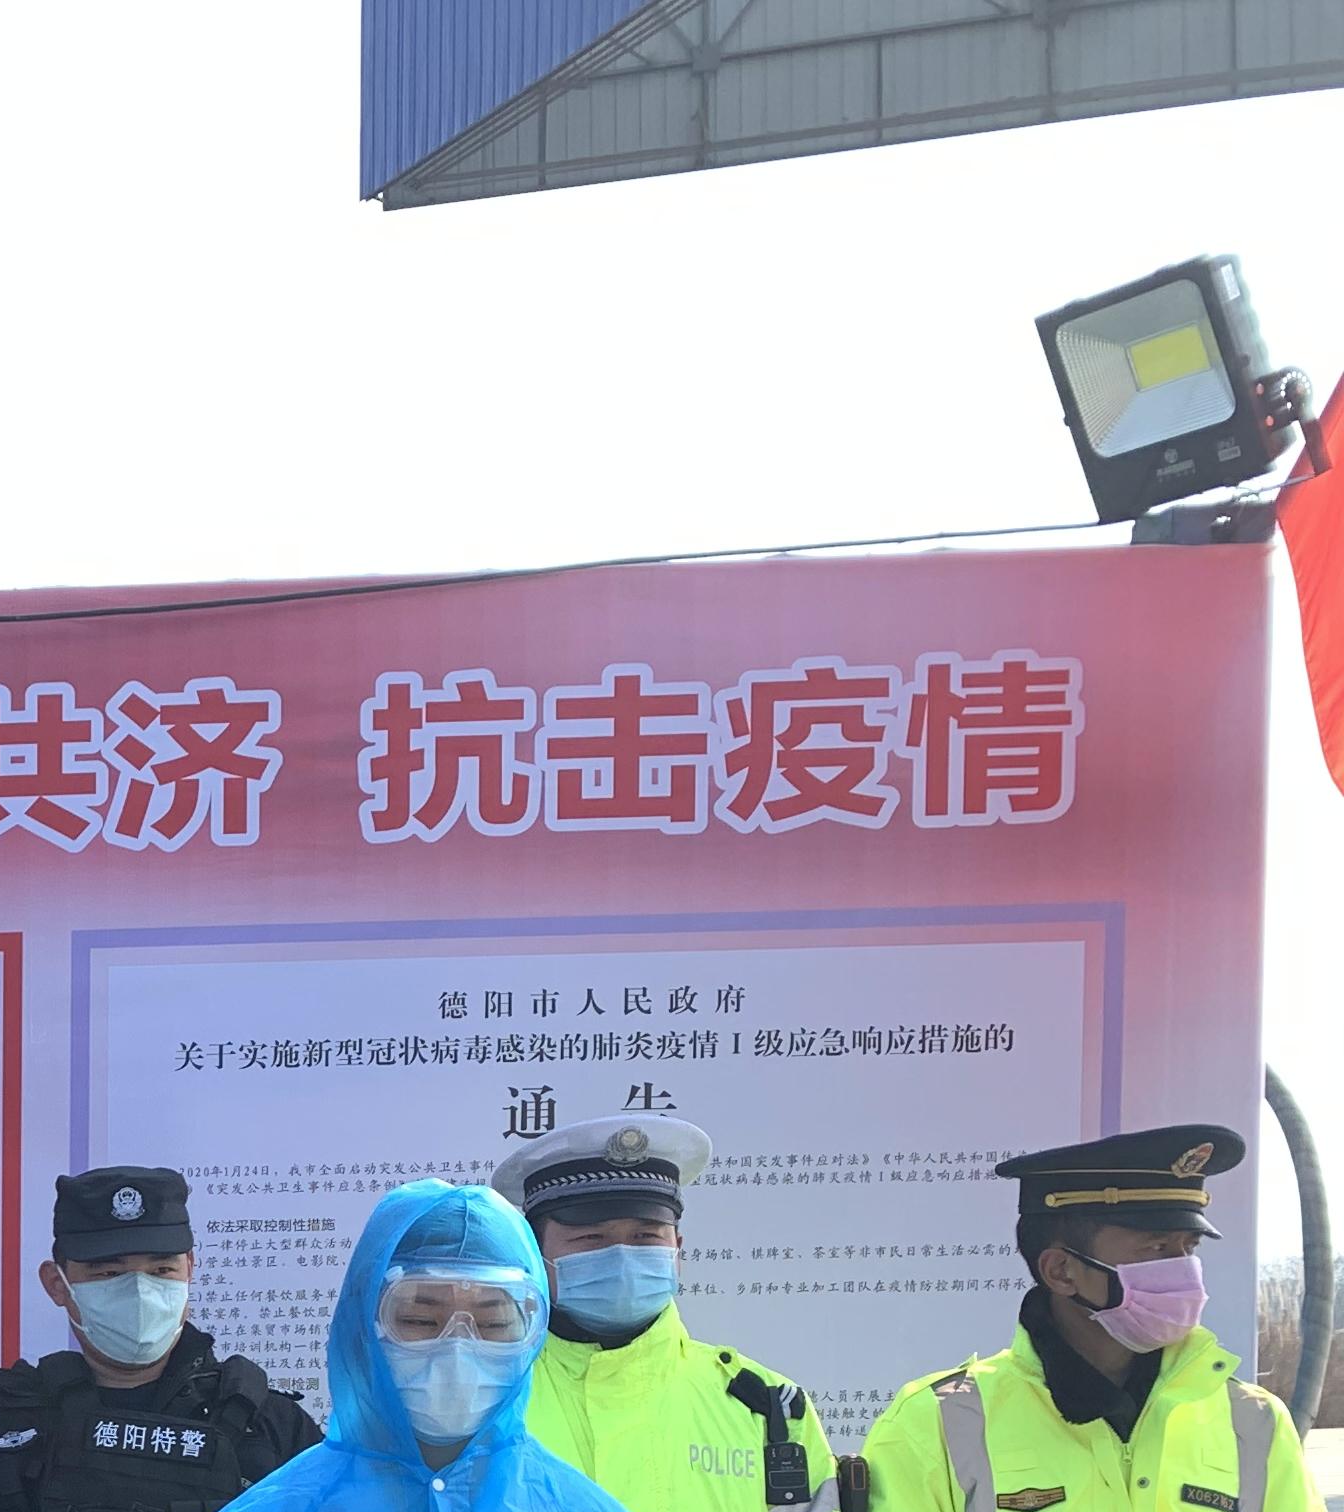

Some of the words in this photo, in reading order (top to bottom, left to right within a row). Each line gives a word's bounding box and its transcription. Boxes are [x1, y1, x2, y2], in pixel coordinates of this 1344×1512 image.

[360, 649, 1087, 845] 抗击疫情
[438, 984, 746, 1019] 德阳市人民政府
[93, 1420, 206, 1458] 德阳特警
[689, 1443, 756, 1479] POLICE
